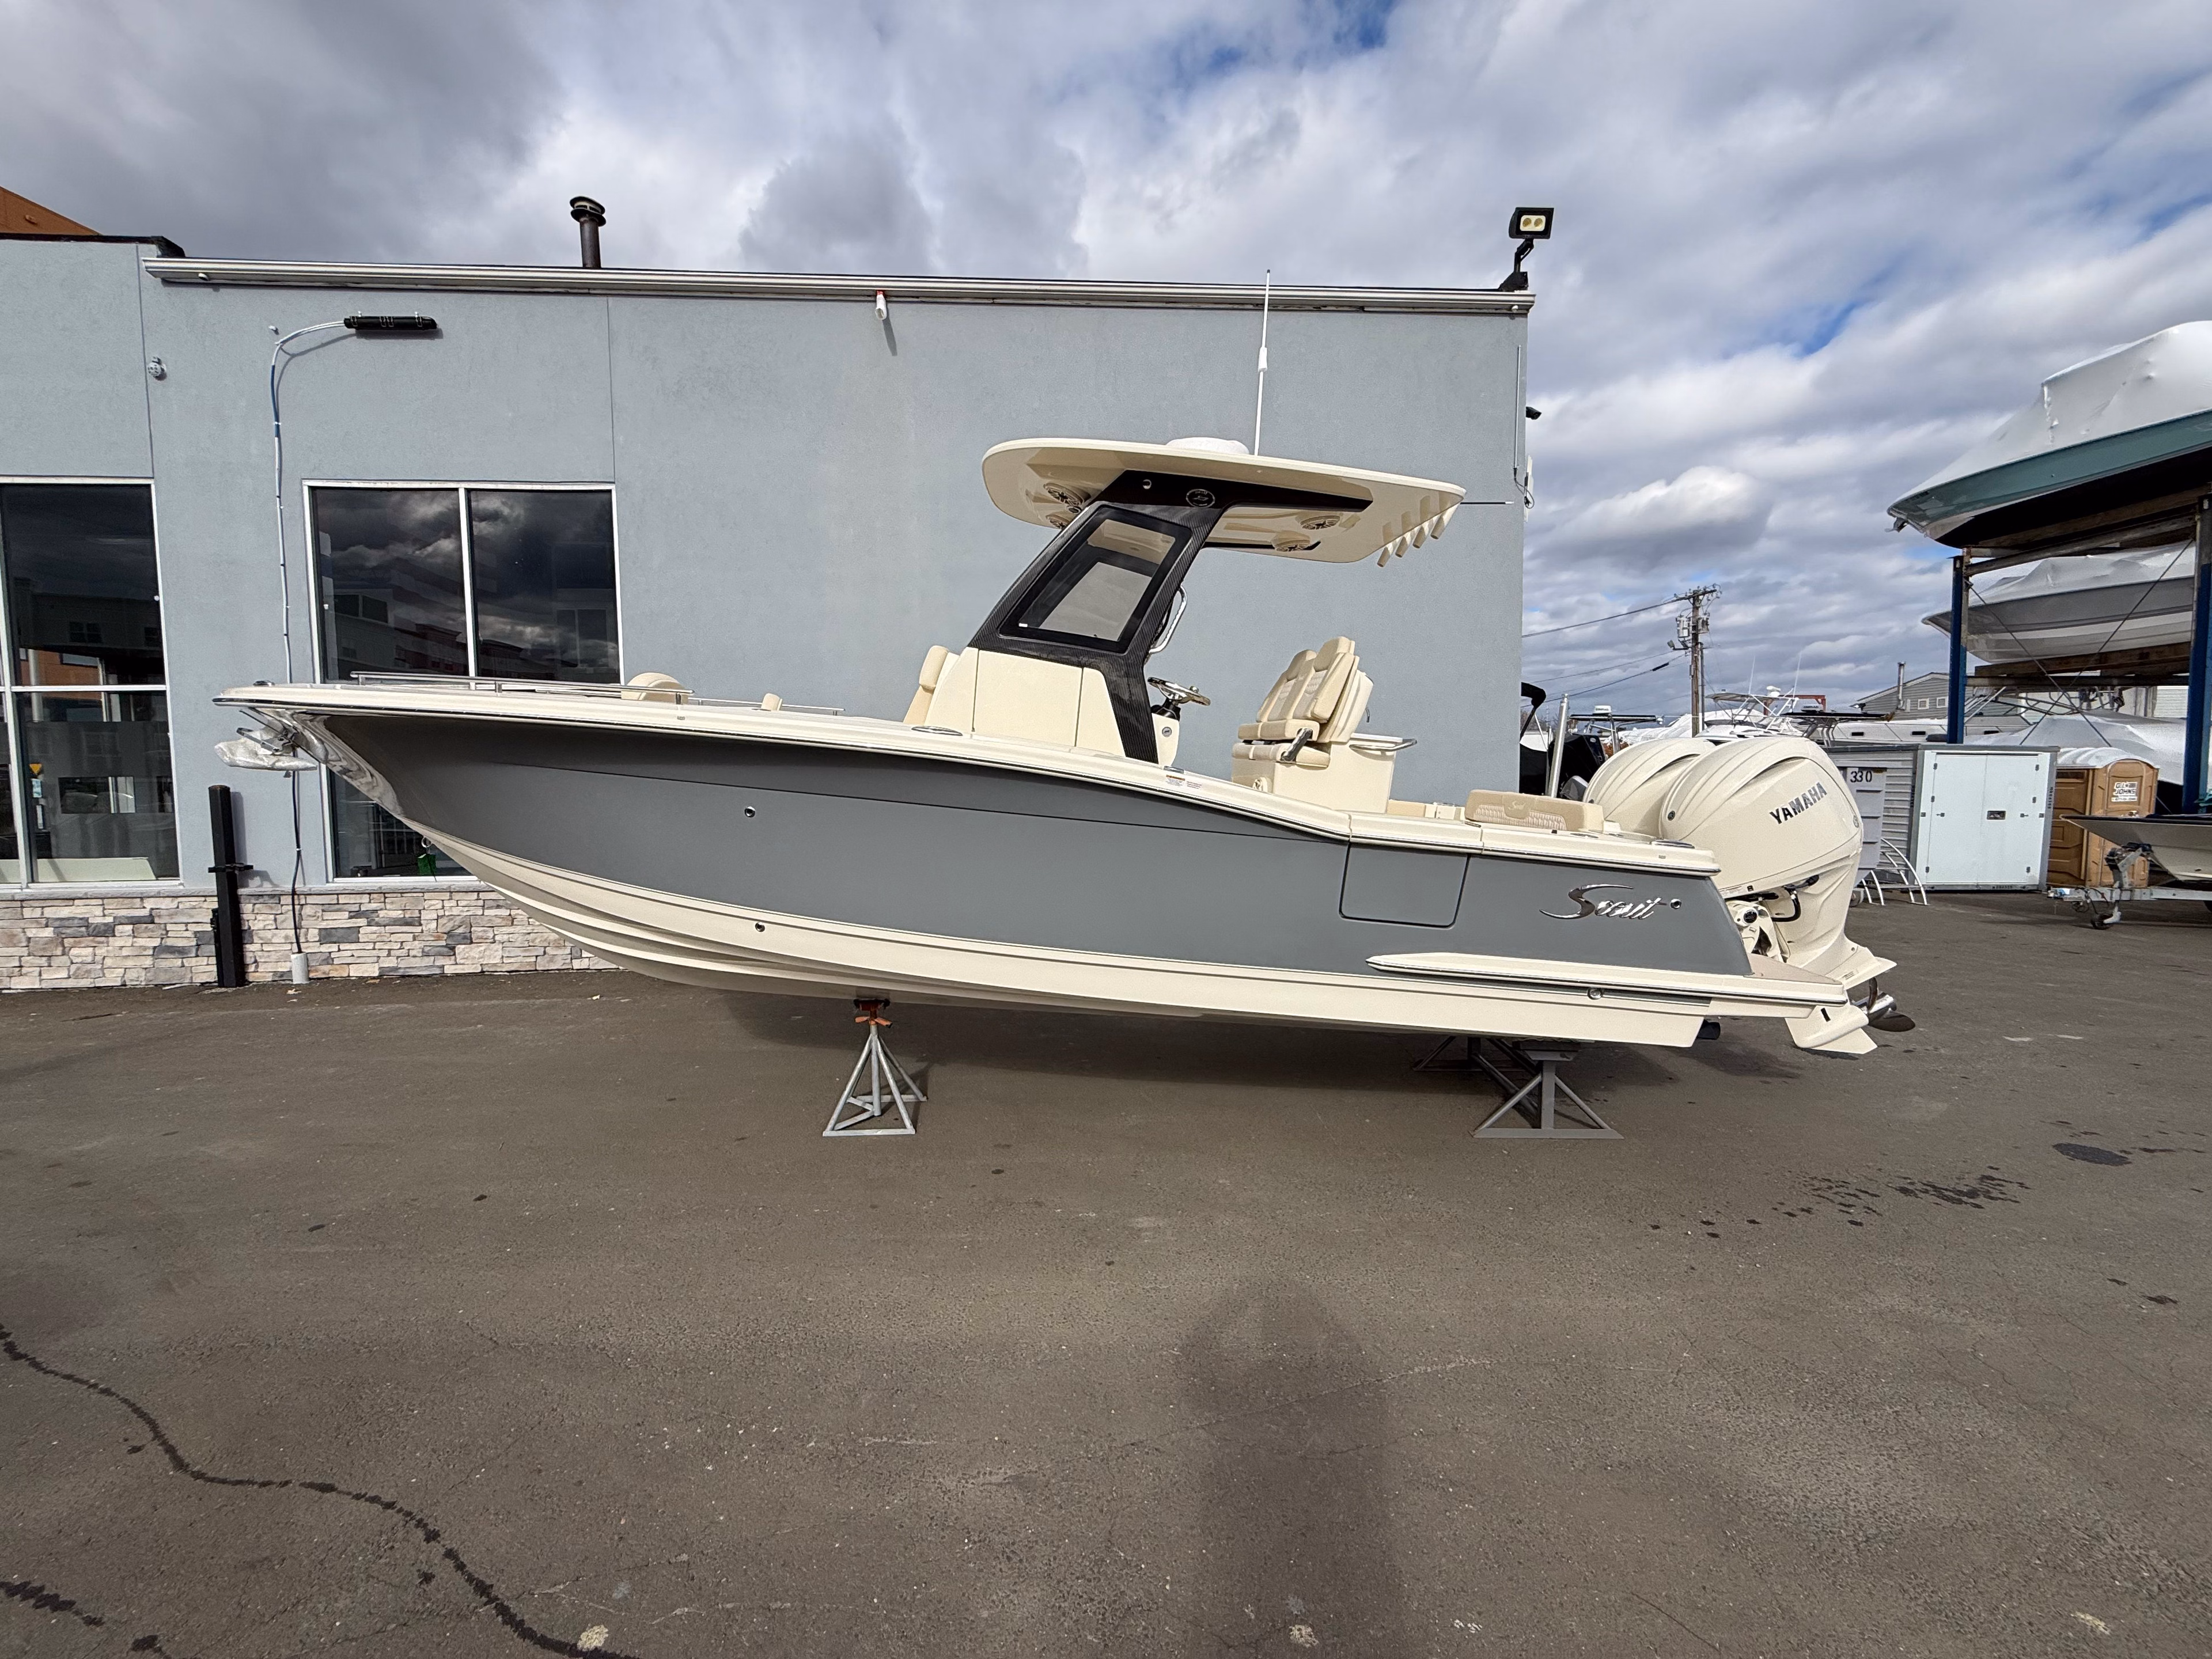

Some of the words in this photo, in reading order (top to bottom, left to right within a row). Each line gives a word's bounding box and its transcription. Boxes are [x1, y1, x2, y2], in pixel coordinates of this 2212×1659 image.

[1850, 771, 1872, 782] 330
[1769, 782, 1827, 824] YAMAHA
[1539, 884, 1667, 919] Scout
